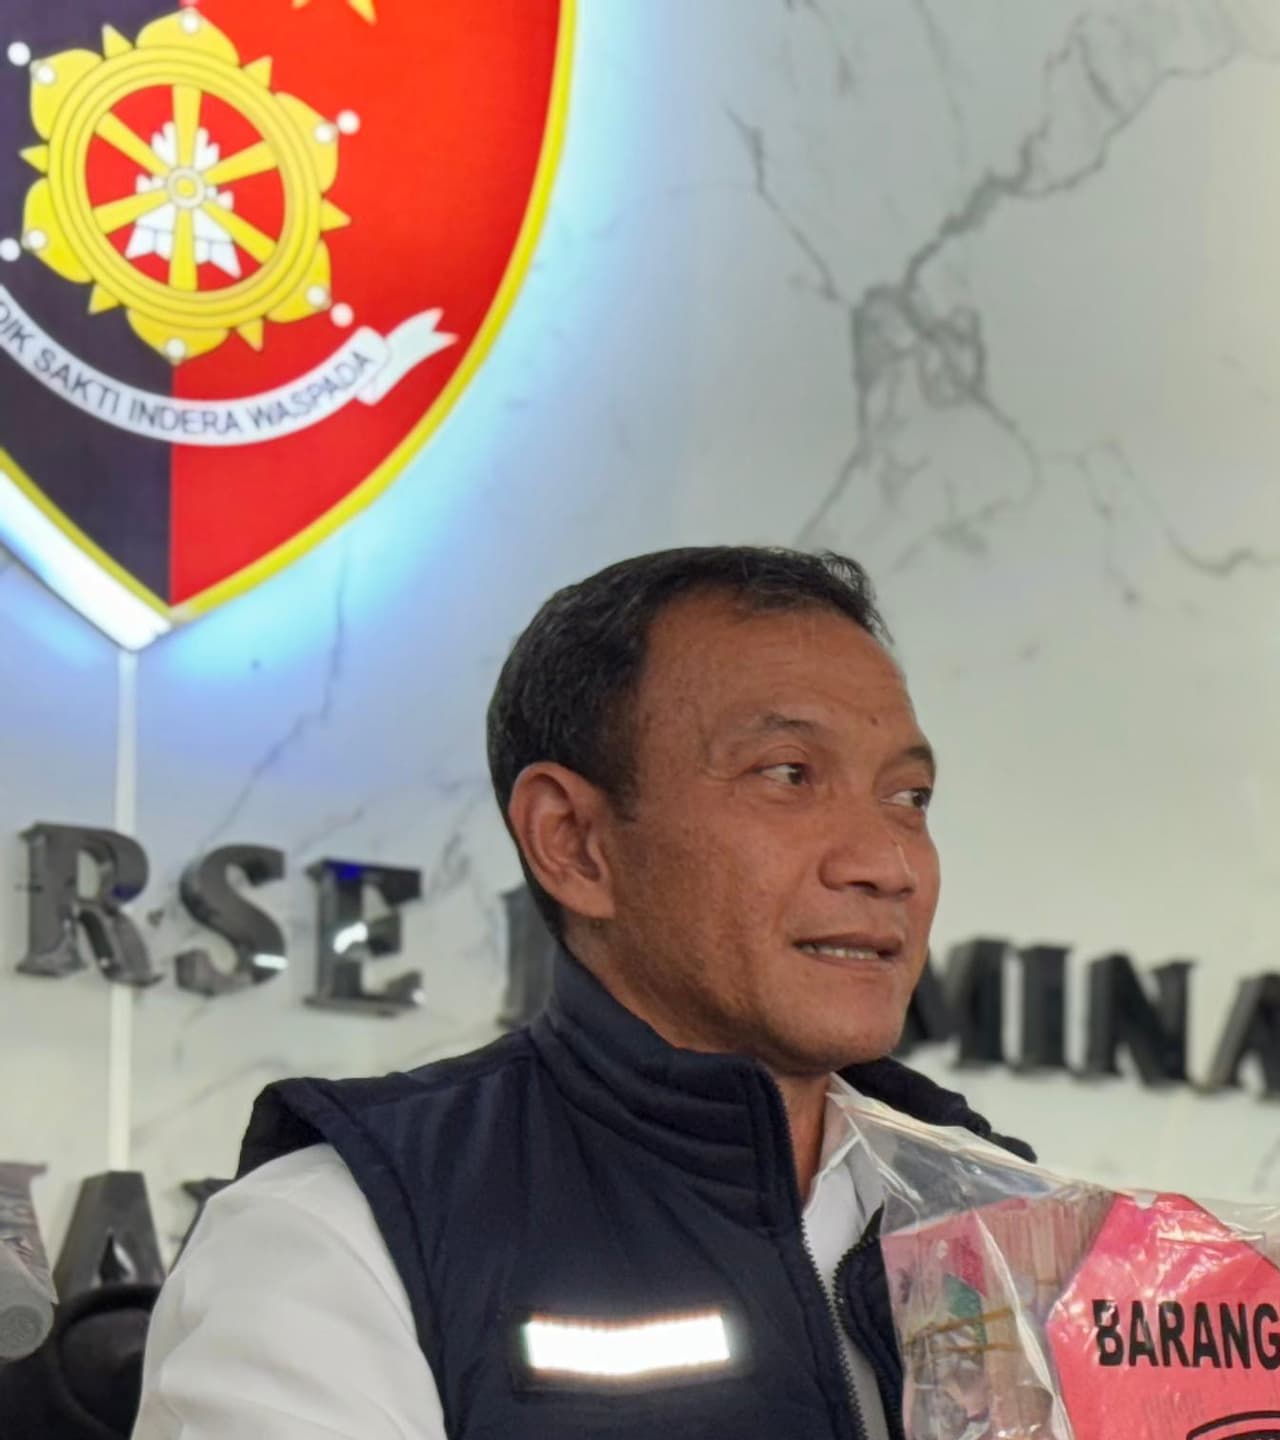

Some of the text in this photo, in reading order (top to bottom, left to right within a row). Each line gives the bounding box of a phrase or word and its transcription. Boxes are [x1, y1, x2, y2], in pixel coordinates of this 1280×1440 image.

[33, 348, 120, 408] SAKTI
[129, 400, 242, 434] INDERA
[248, 350, 373, 430] WASPADA
